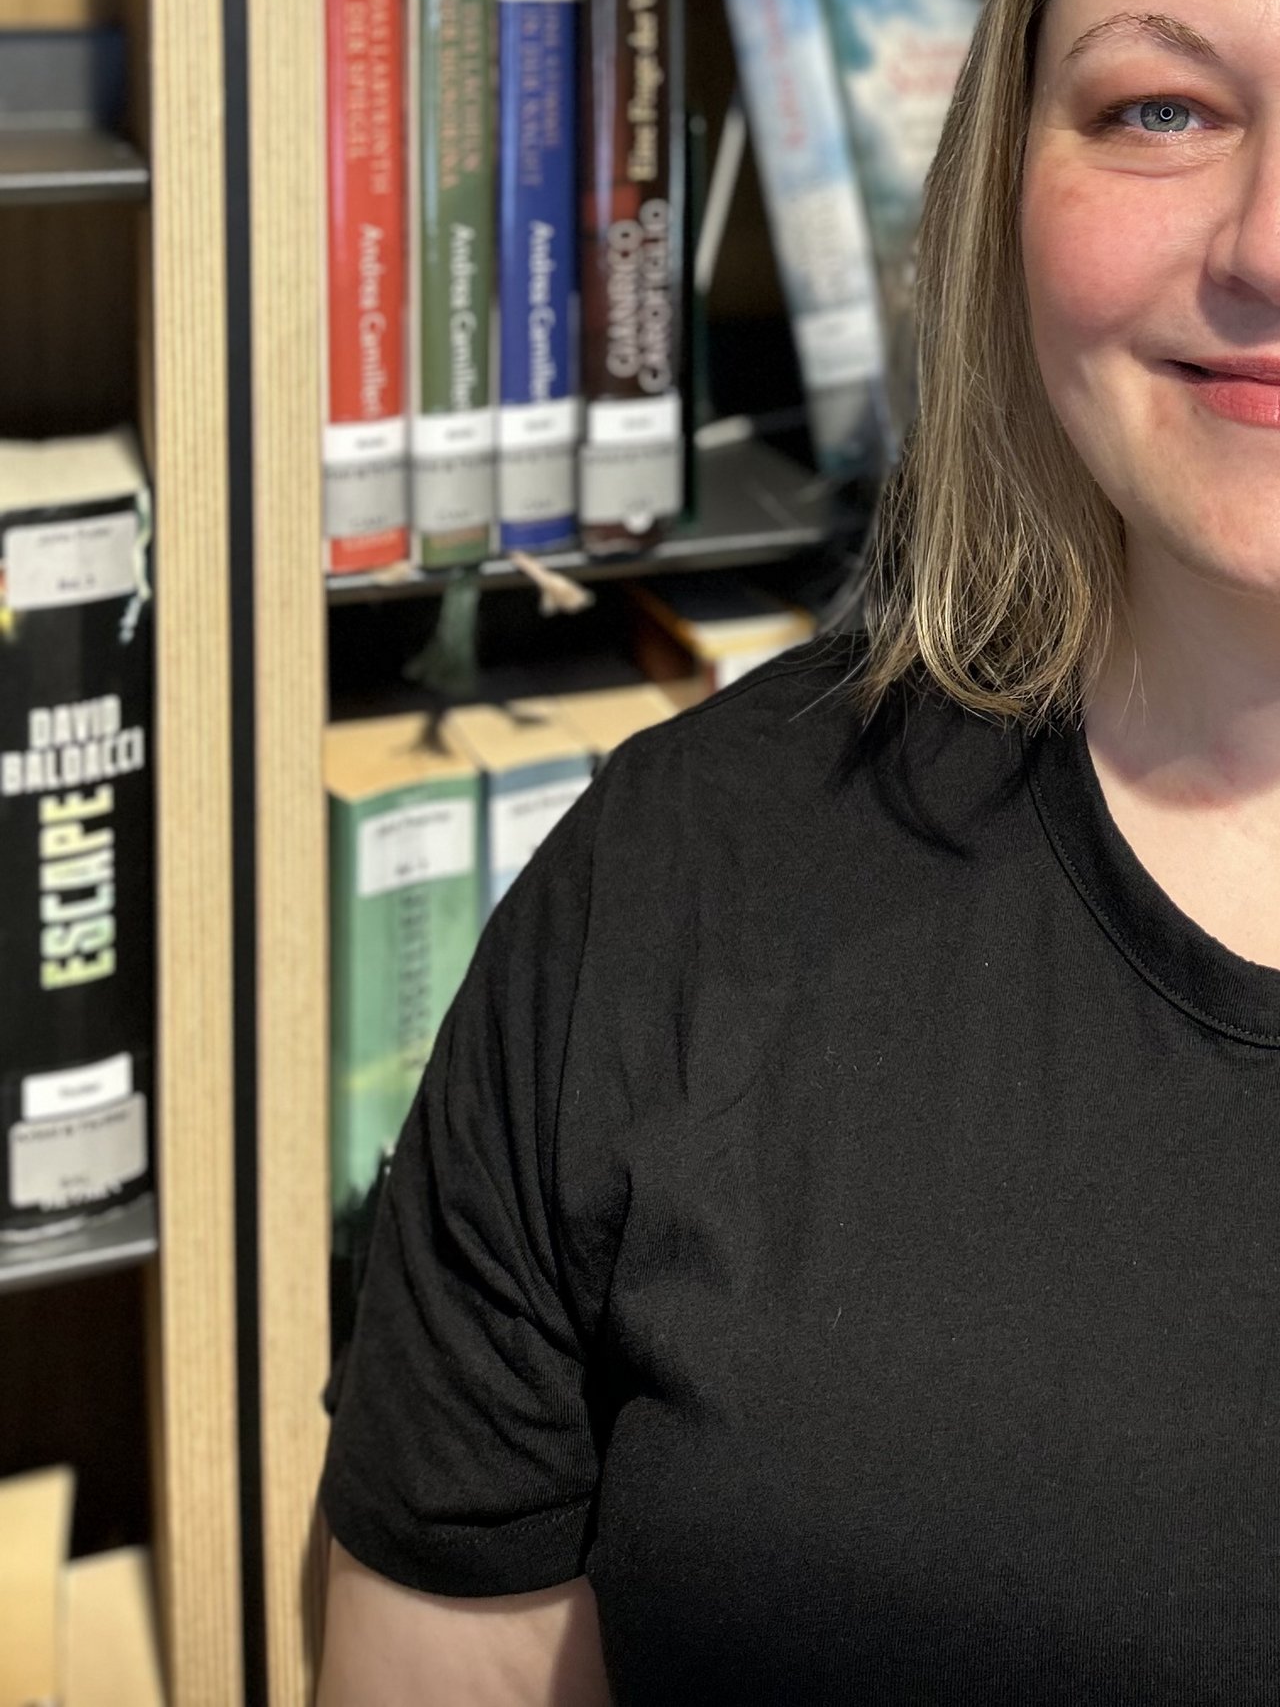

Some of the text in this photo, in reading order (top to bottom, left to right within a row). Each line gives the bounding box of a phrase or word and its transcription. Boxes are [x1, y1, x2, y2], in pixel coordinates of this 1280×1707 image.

[359, 223, 384, 308] Andrea
[450, 223, 476, 308] Andrea
[530, 222, 554, 403] Andrea Camiller
[1, 725, 145, 796] BALDACCI
[28, 694, 122, 750] DAVID
[39, 782, 116, 991] ESCAPE
